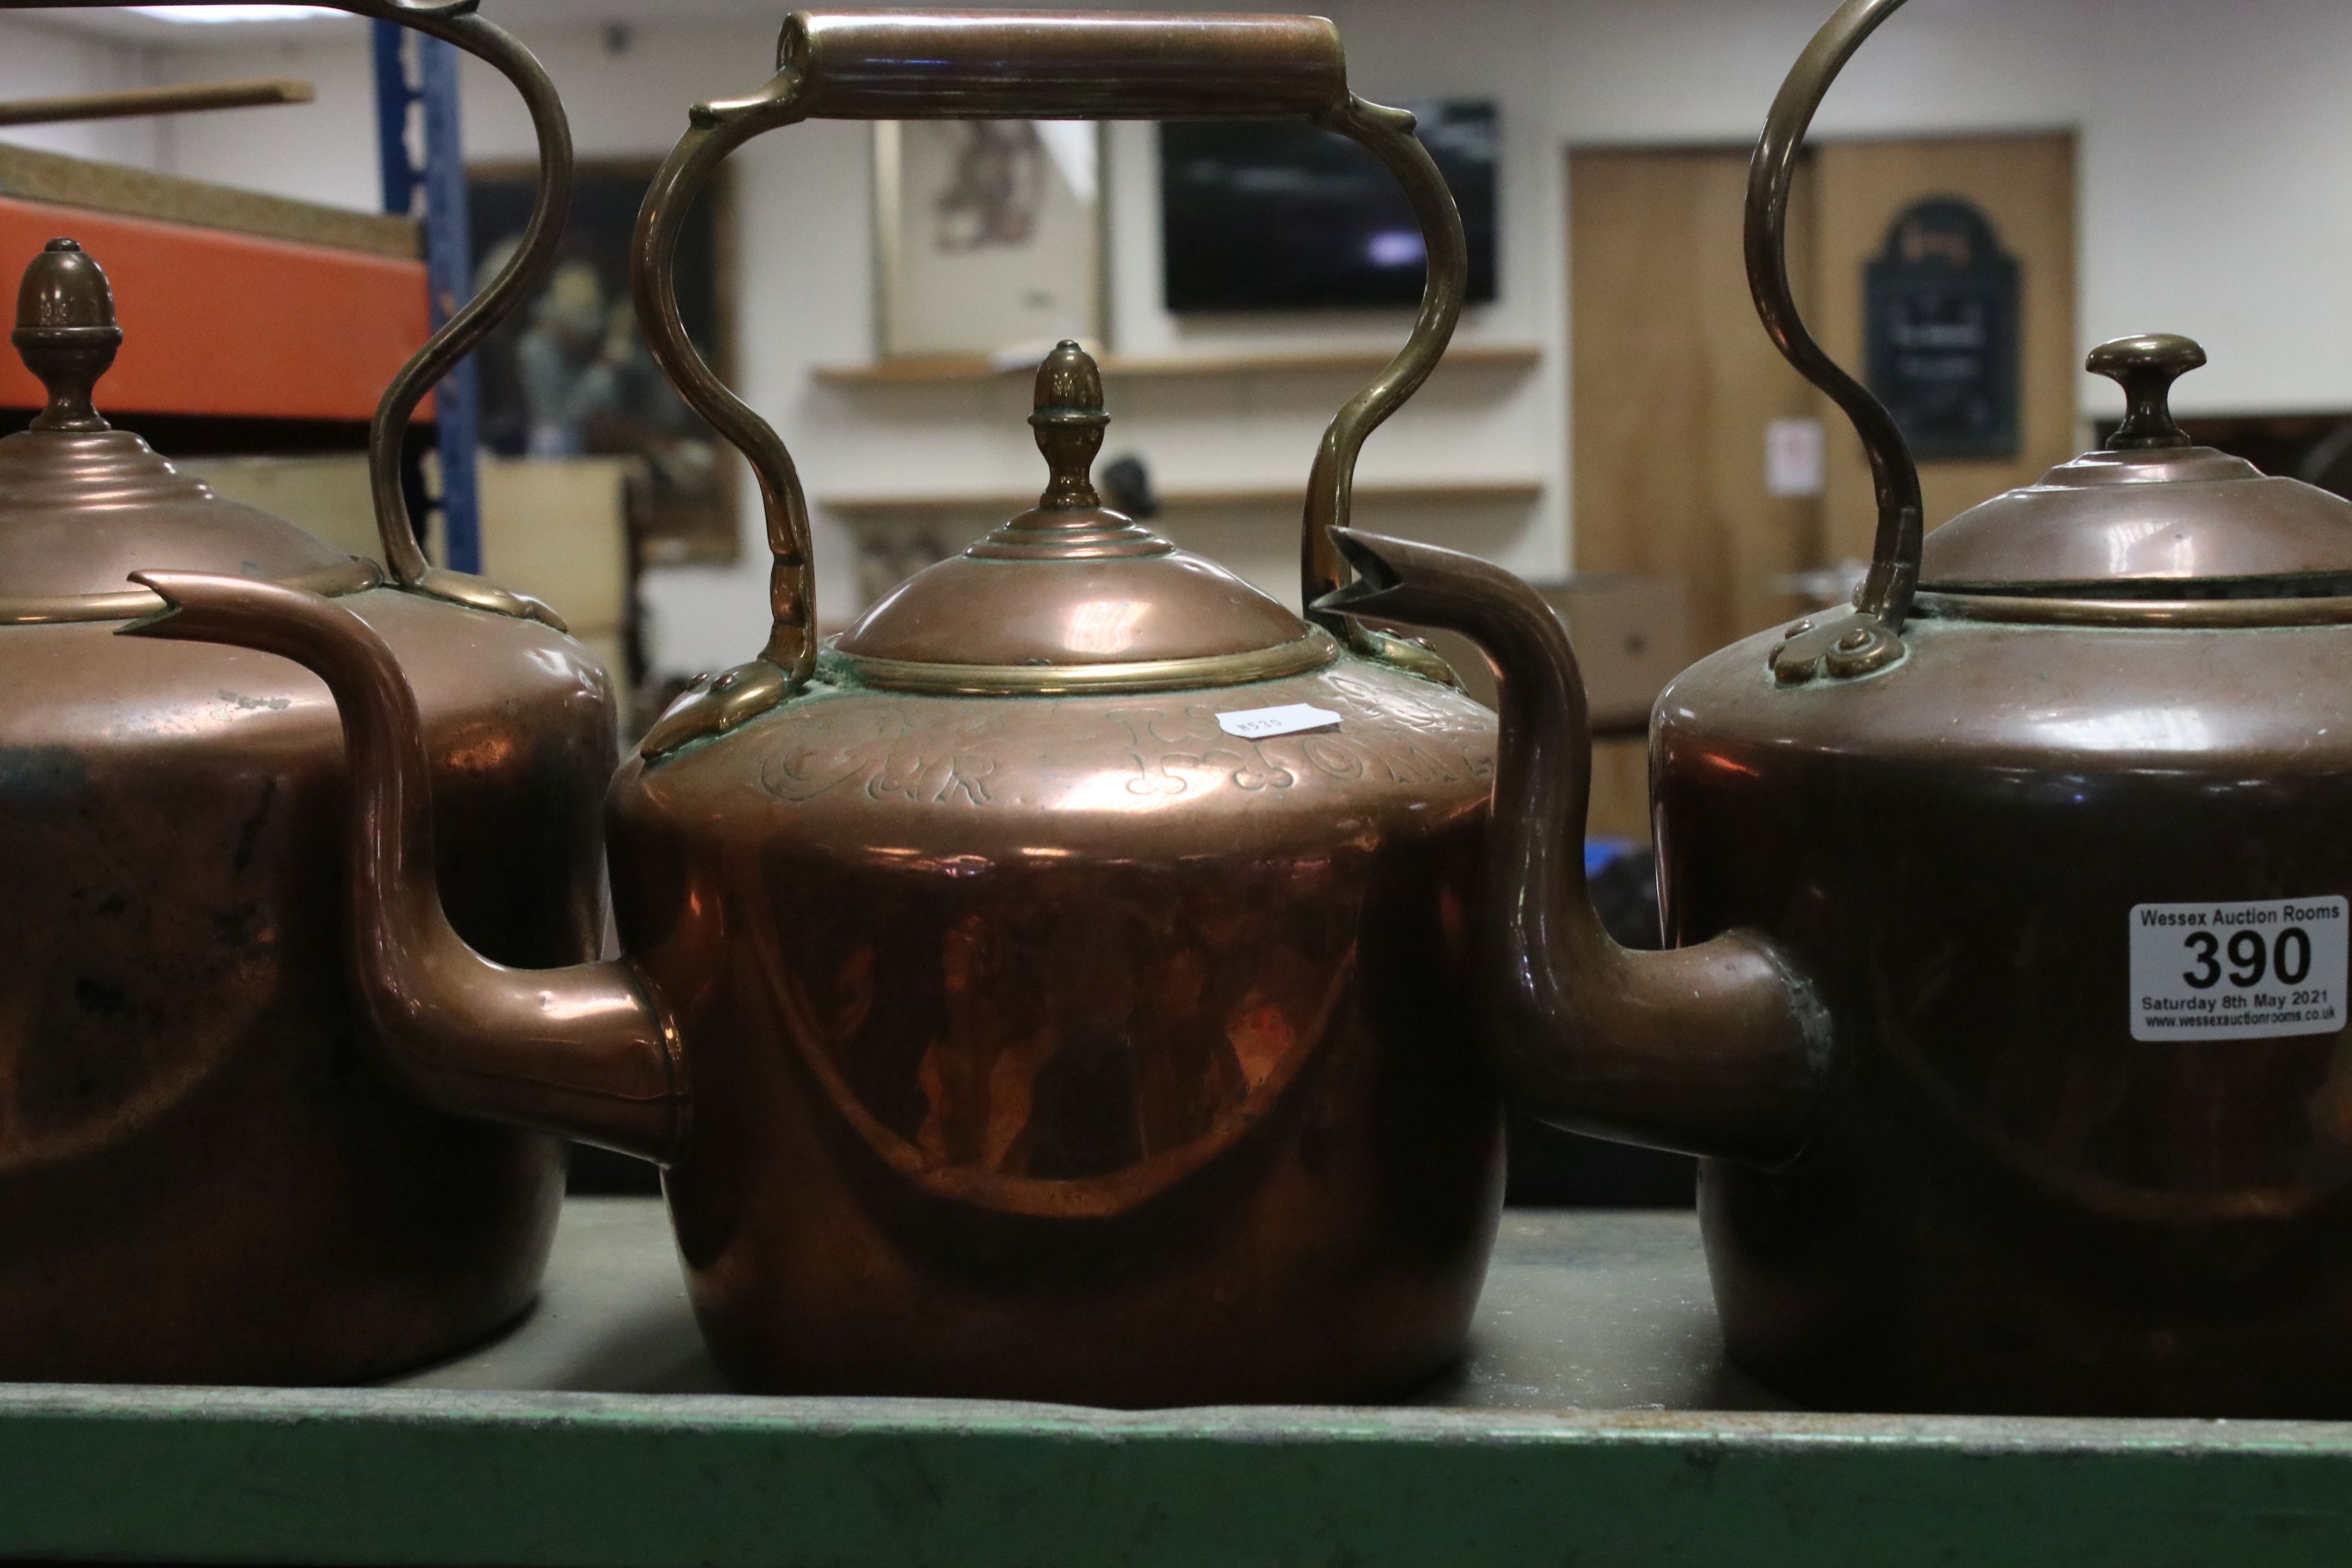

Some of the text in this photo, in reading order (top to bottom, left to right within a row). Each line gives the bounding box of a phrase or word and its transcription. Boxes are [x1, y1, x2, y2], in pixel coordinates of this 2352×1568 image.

[2140, 905, 2340, 926] Wessex Auction Rooms
[2183, 927, 2312, 989] 390
[2141, 989, 2329, 1013] Saturday 8th May 2021
[2145, 1005, 2336, 1028] www.wessexauctionrooms.co.uk
